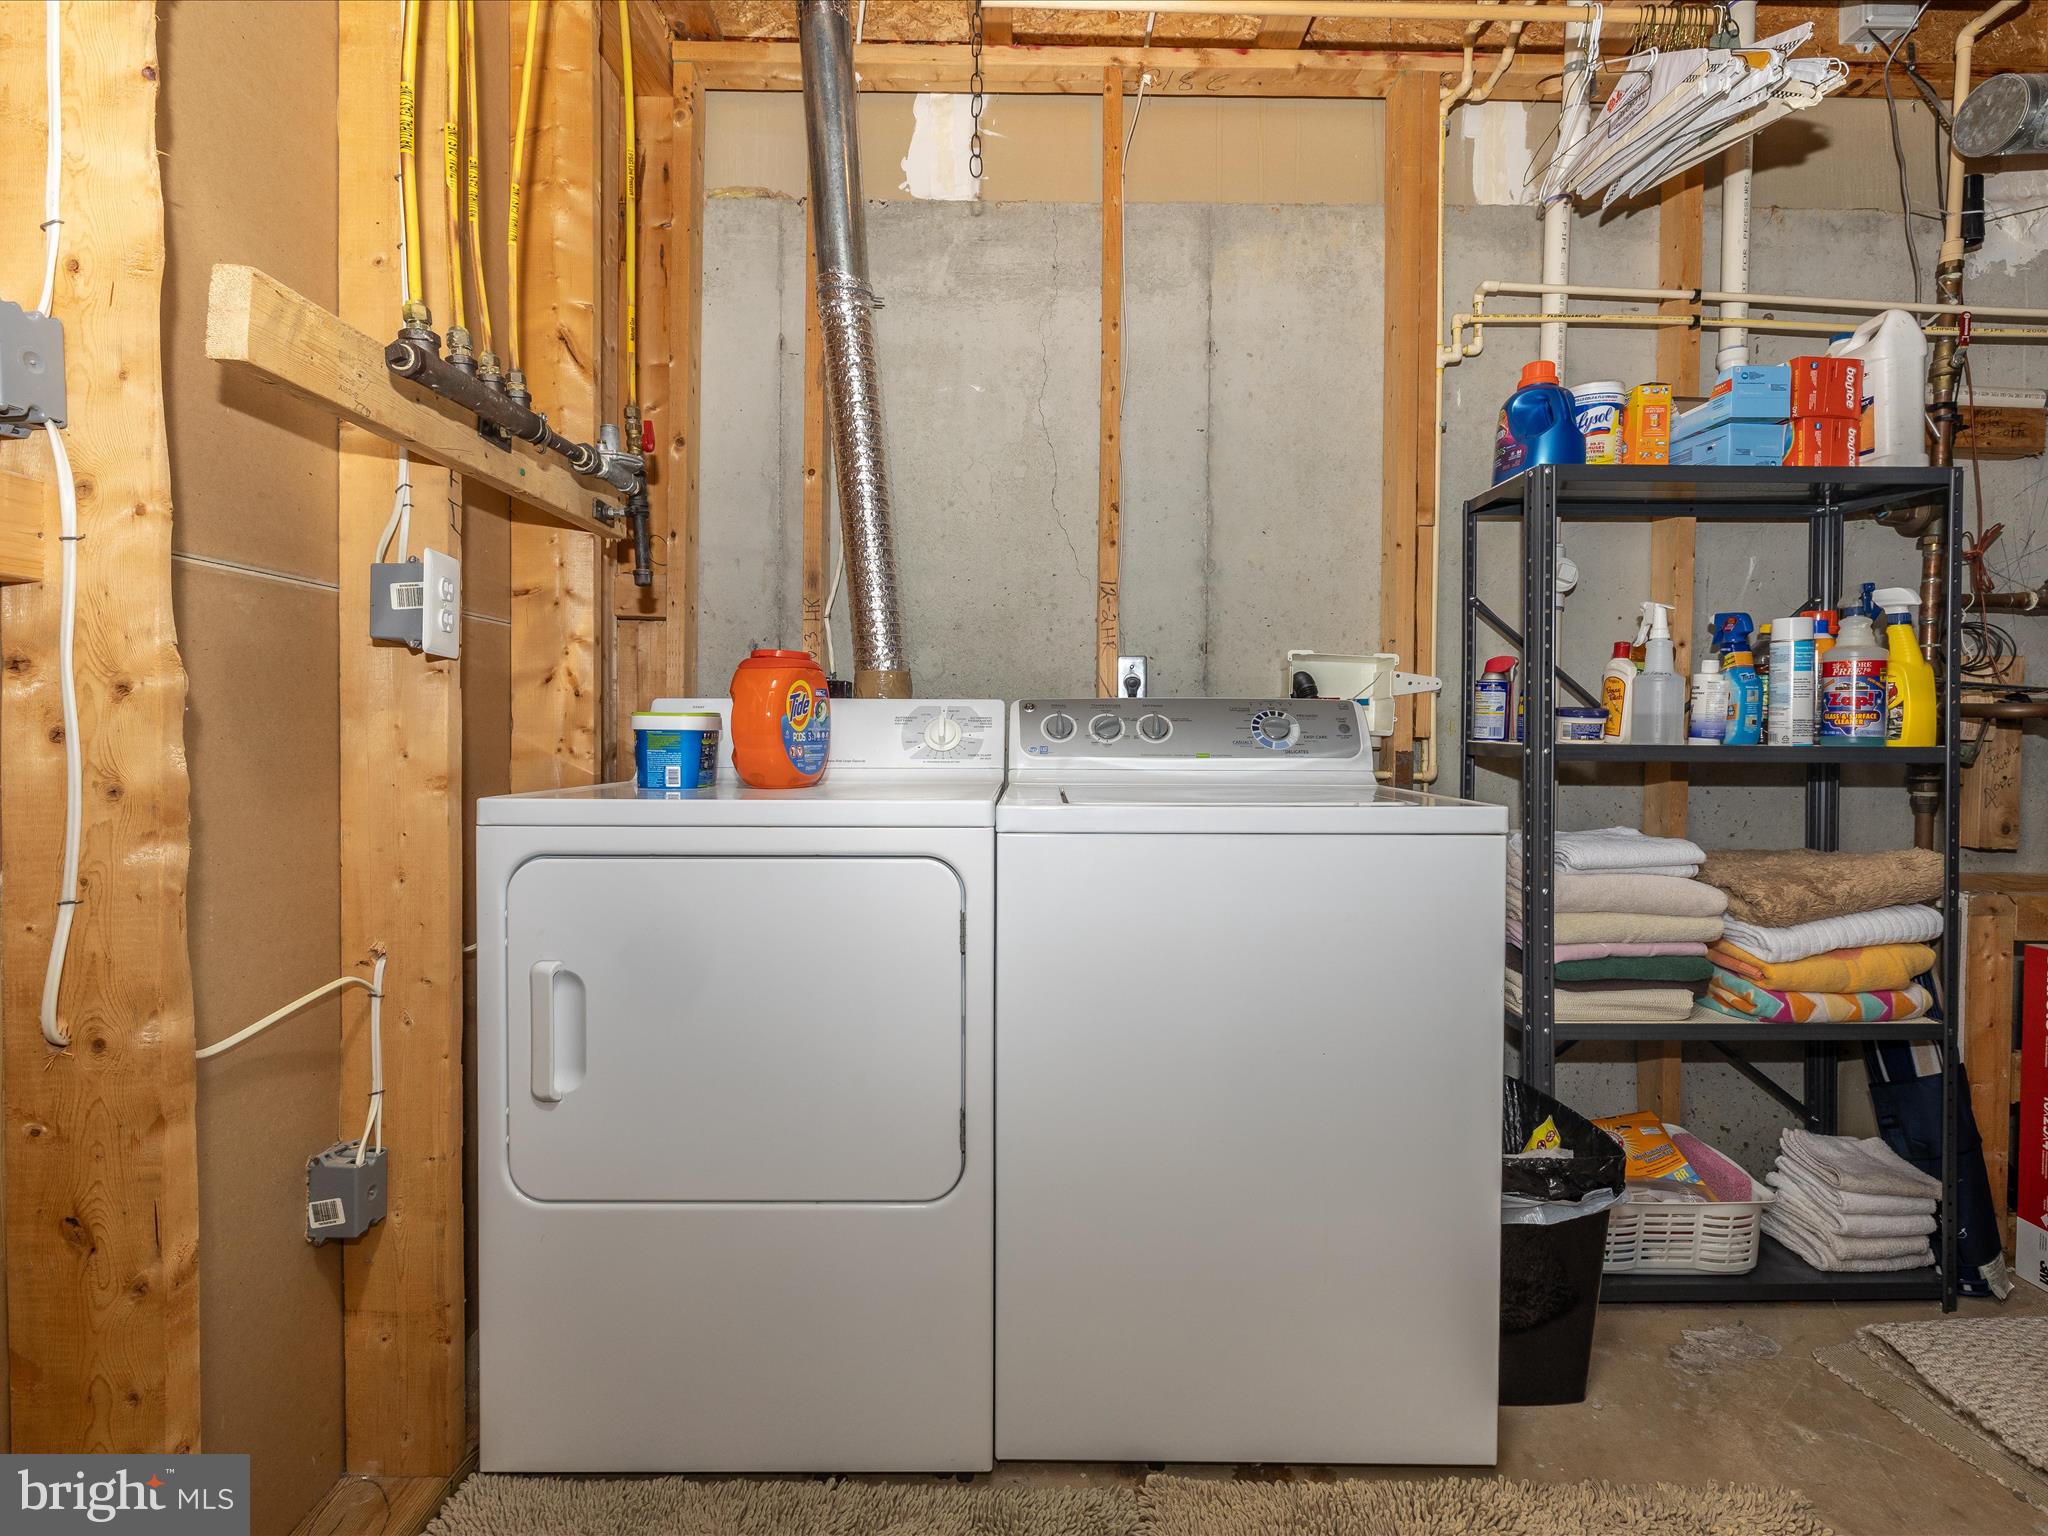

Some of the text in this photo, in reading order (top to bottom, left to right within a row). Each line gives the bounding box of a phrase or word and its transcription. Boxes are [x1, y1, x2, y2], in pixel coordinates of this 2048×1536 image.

[400, 102, 412, 118] GAS
[400, 119, 412, 150] NATURAL
[1845, 367, 1857, 409] bounce
[1578, 407, 1613, 433] Lysol
[789, 693, 810, 723] Tide
[1828, 691, 1875, 711] Zap!
